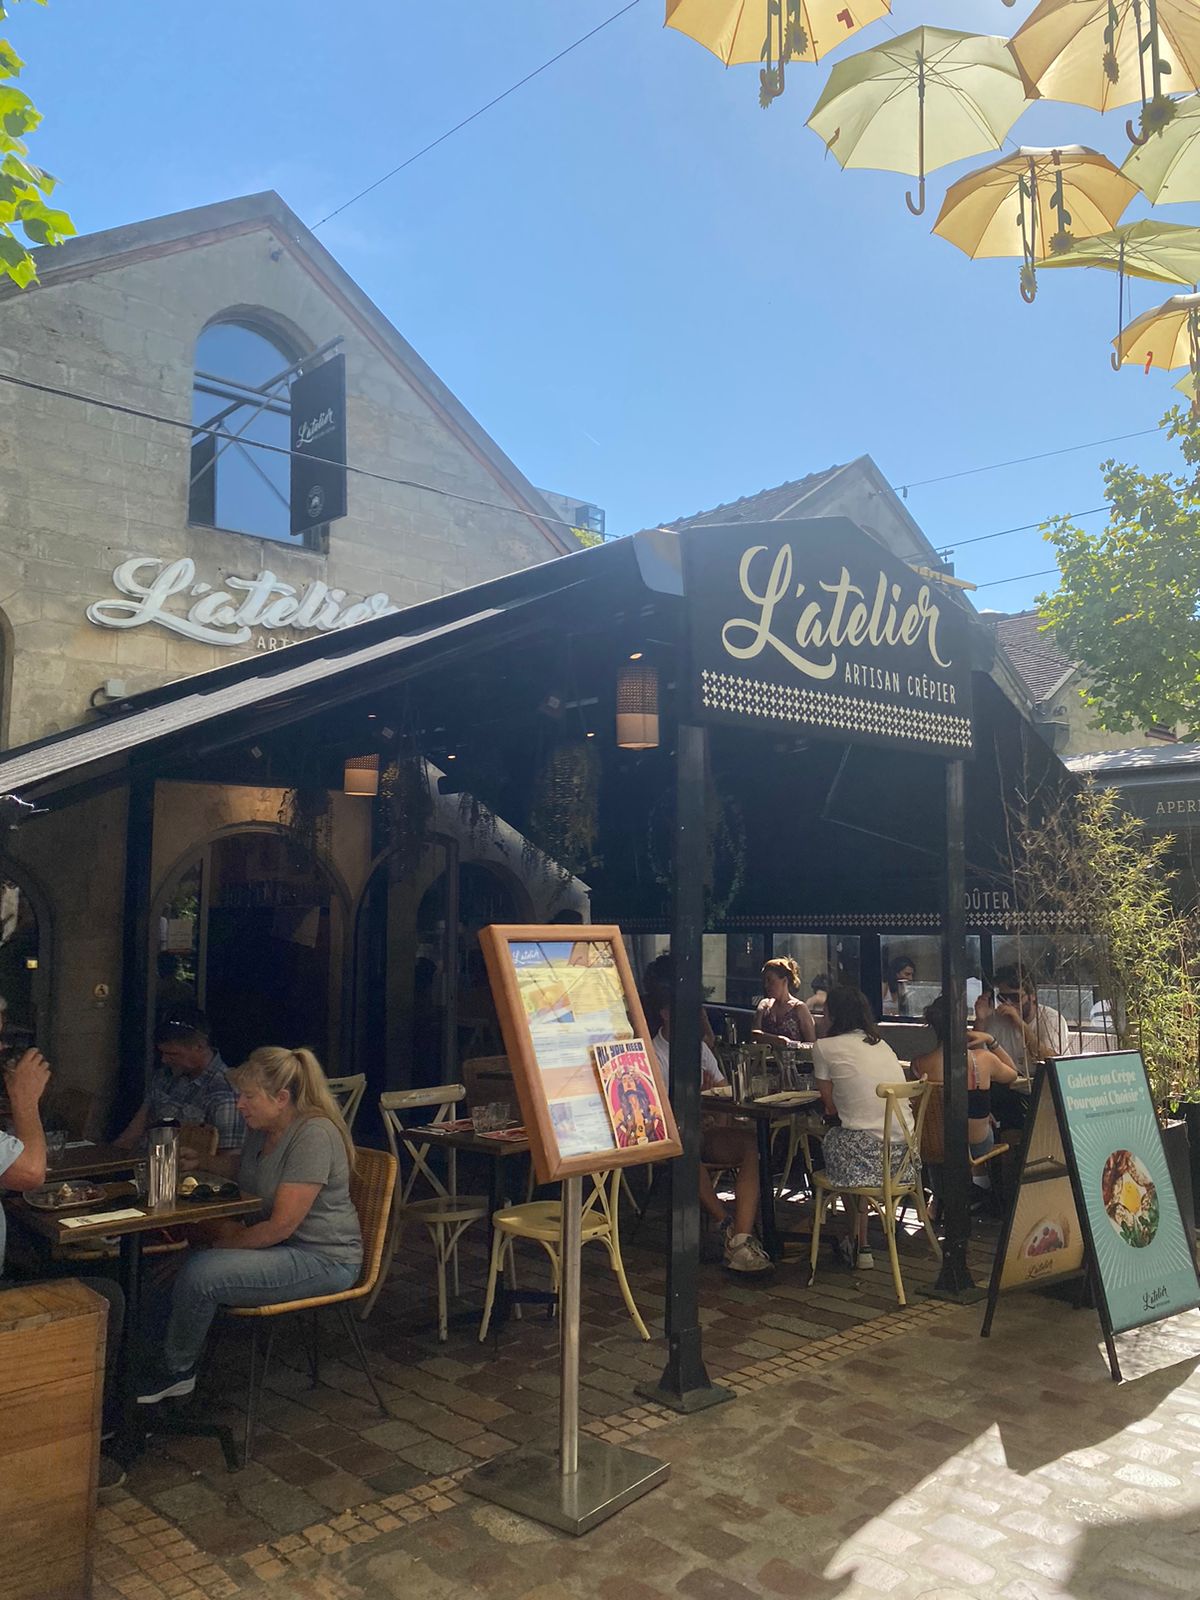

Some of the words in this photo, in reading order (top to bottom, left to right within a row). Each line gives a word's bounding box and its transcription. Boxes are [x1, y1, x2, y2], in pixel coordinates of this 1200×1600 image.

[721, 543, 952, 680] L'atelier
[257, 636, 300, 650] ART
[845, 661, 900, 693] ARTISAN
[907, 673, 956, 705] CRÊPIER
[964, 888, 1010, 910] OÛTER
[596, 1045, 610, 1069] ALL
[609, 1043, 625, 1058] YOU
[626, 1041, 644, 1052] NEED
[1067, 1073, 1100, 1089] Galette
[1100, 1073, 1112, 1085] ou
[1066, 1091, 1109, 1111] Pourquoi
